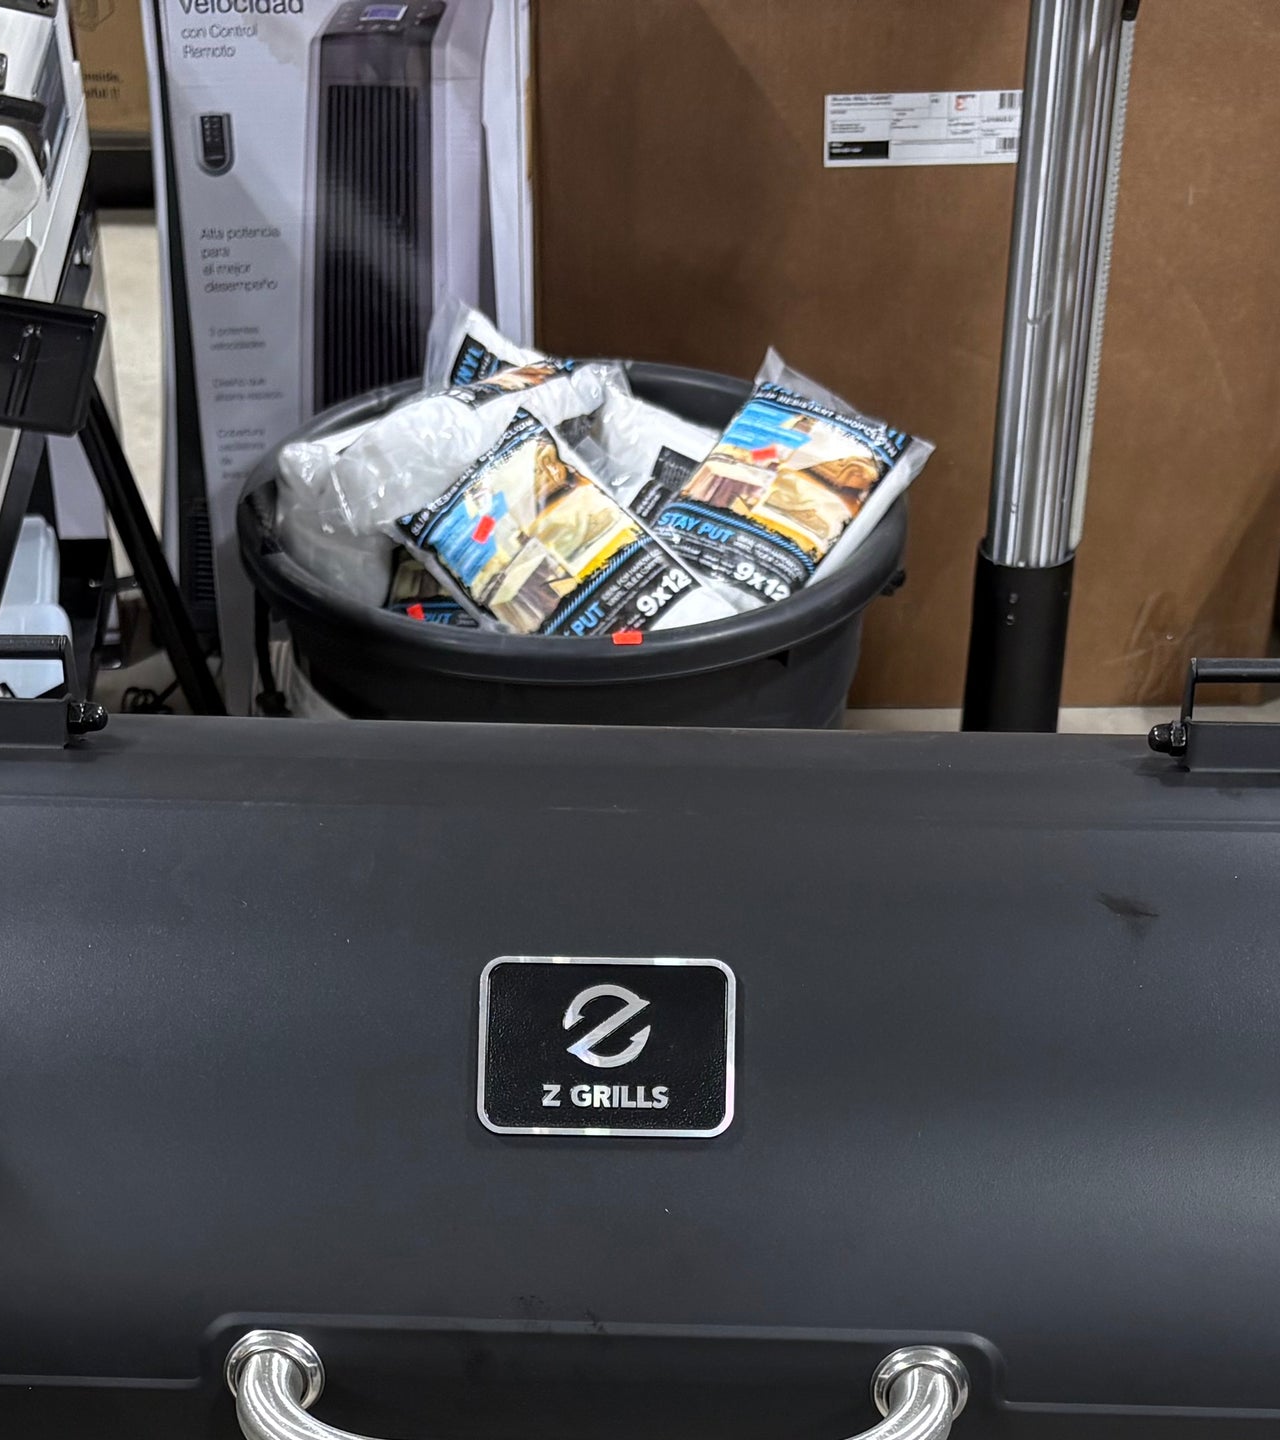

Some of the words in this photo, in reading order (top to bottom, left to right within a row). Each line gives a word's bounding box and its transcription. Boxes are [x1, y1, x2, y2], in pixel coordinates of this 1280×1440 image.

[182, 27, 207, 39] con
[209, 25, 258, 39] Control
[183, 45, 236, 58] Remoto
[658, 511, 699, 534] STAY
[698, 521, 737, 544] PUT
[636, 566, 693, 618] 9x12
[733, 561, 791, 601] 9x12
[542, 1084, 561, 1107] Z
[570, 1084, 669, 1109] GRILLS
